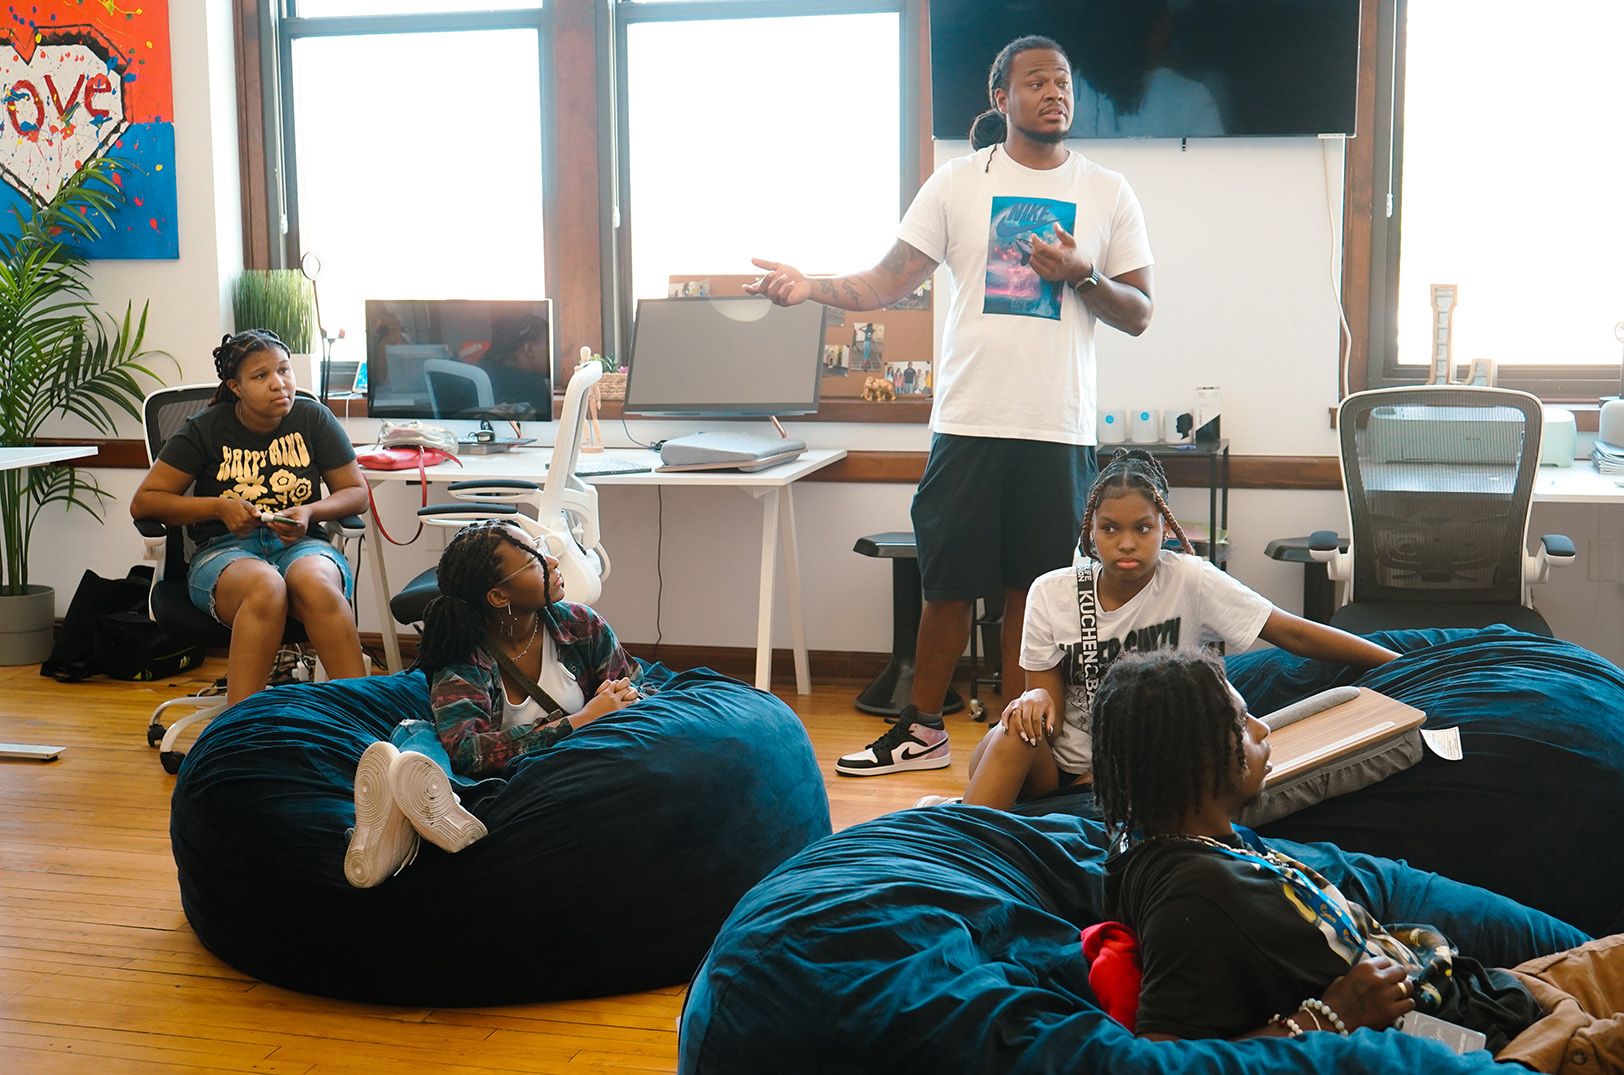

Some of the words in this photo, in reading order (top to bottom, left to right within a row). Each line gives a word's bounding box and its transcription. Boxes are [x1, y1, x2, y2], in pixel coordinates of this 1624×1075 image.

[1006, 203, 1053, 222] NIKE
[216, 445, 268, 481] HAPPY
[268, 432, 310, 467] MIND
